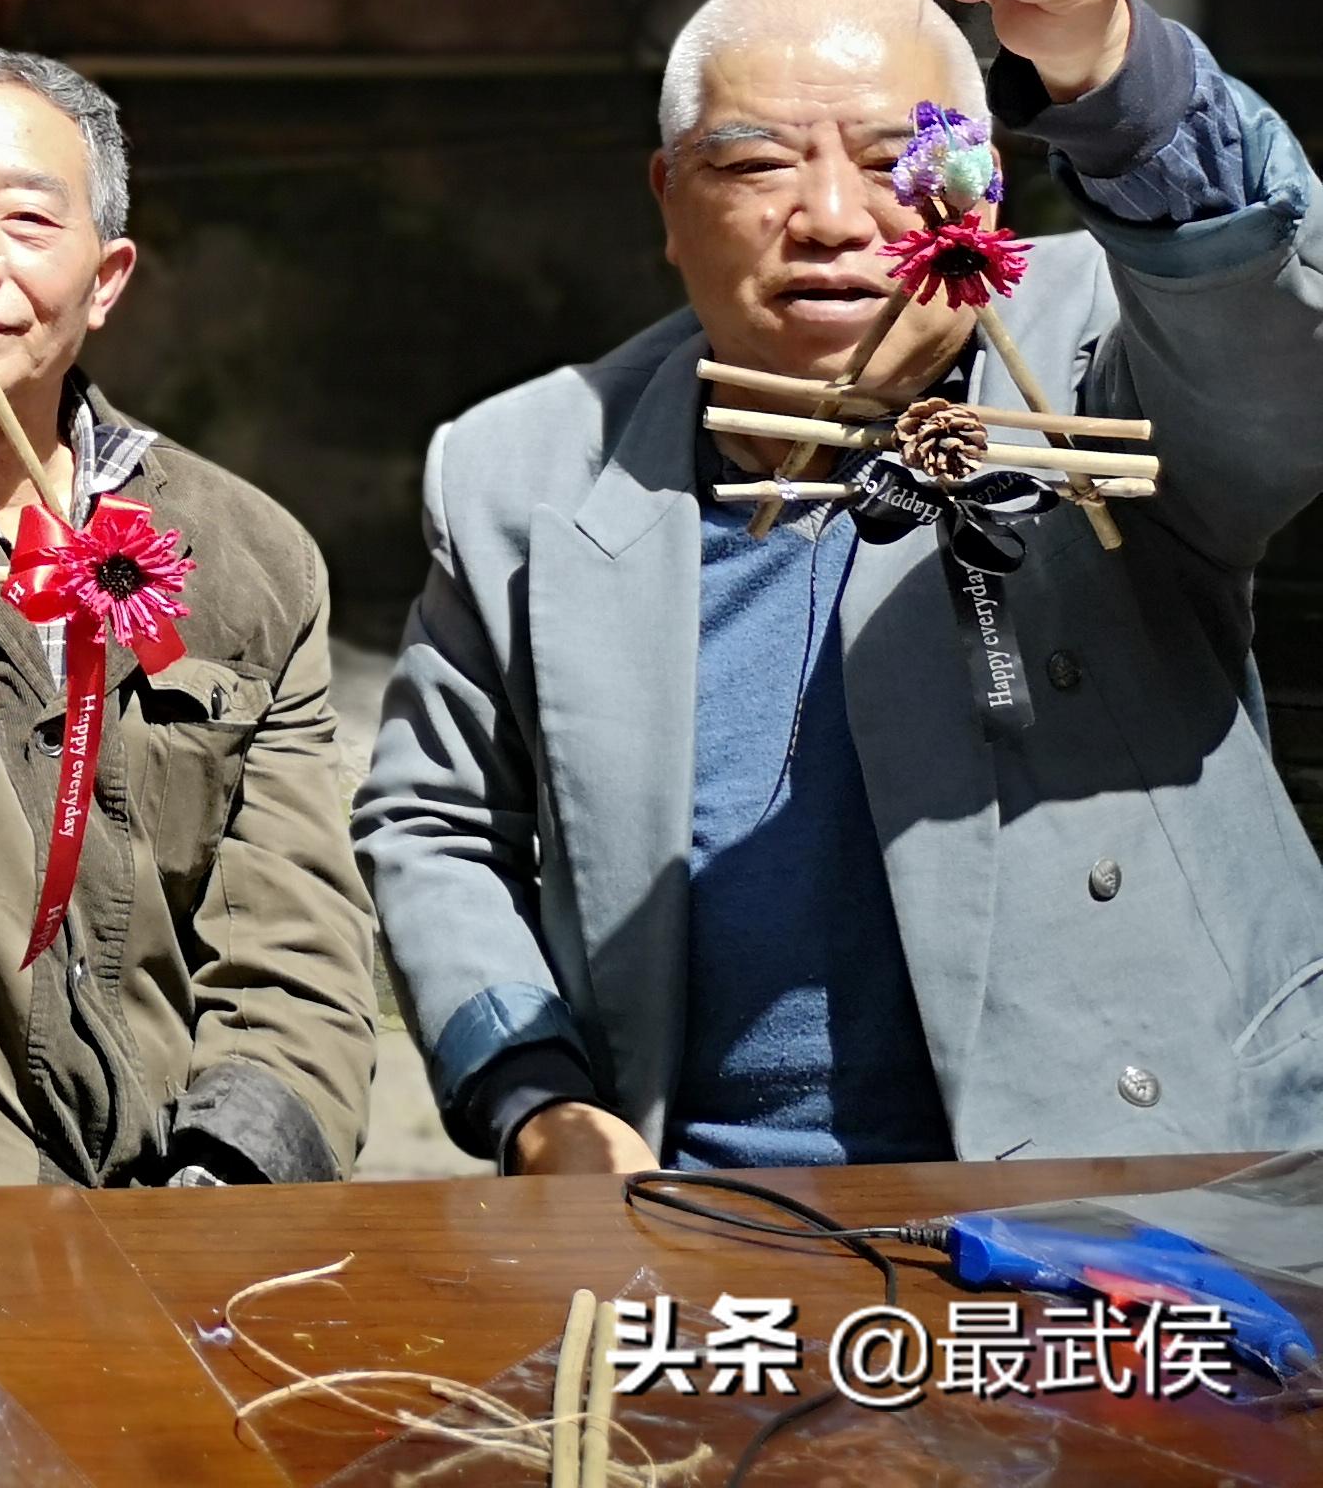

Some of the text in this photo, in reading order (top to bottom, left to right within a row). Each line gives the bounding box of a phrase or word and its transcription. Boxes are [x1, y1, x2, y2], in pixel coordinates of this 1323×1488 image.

[877, 482, 943, 524] Happy
[987, 649, 1014, 709] Happy
[58, 693, 97, 838] Happy everyday
